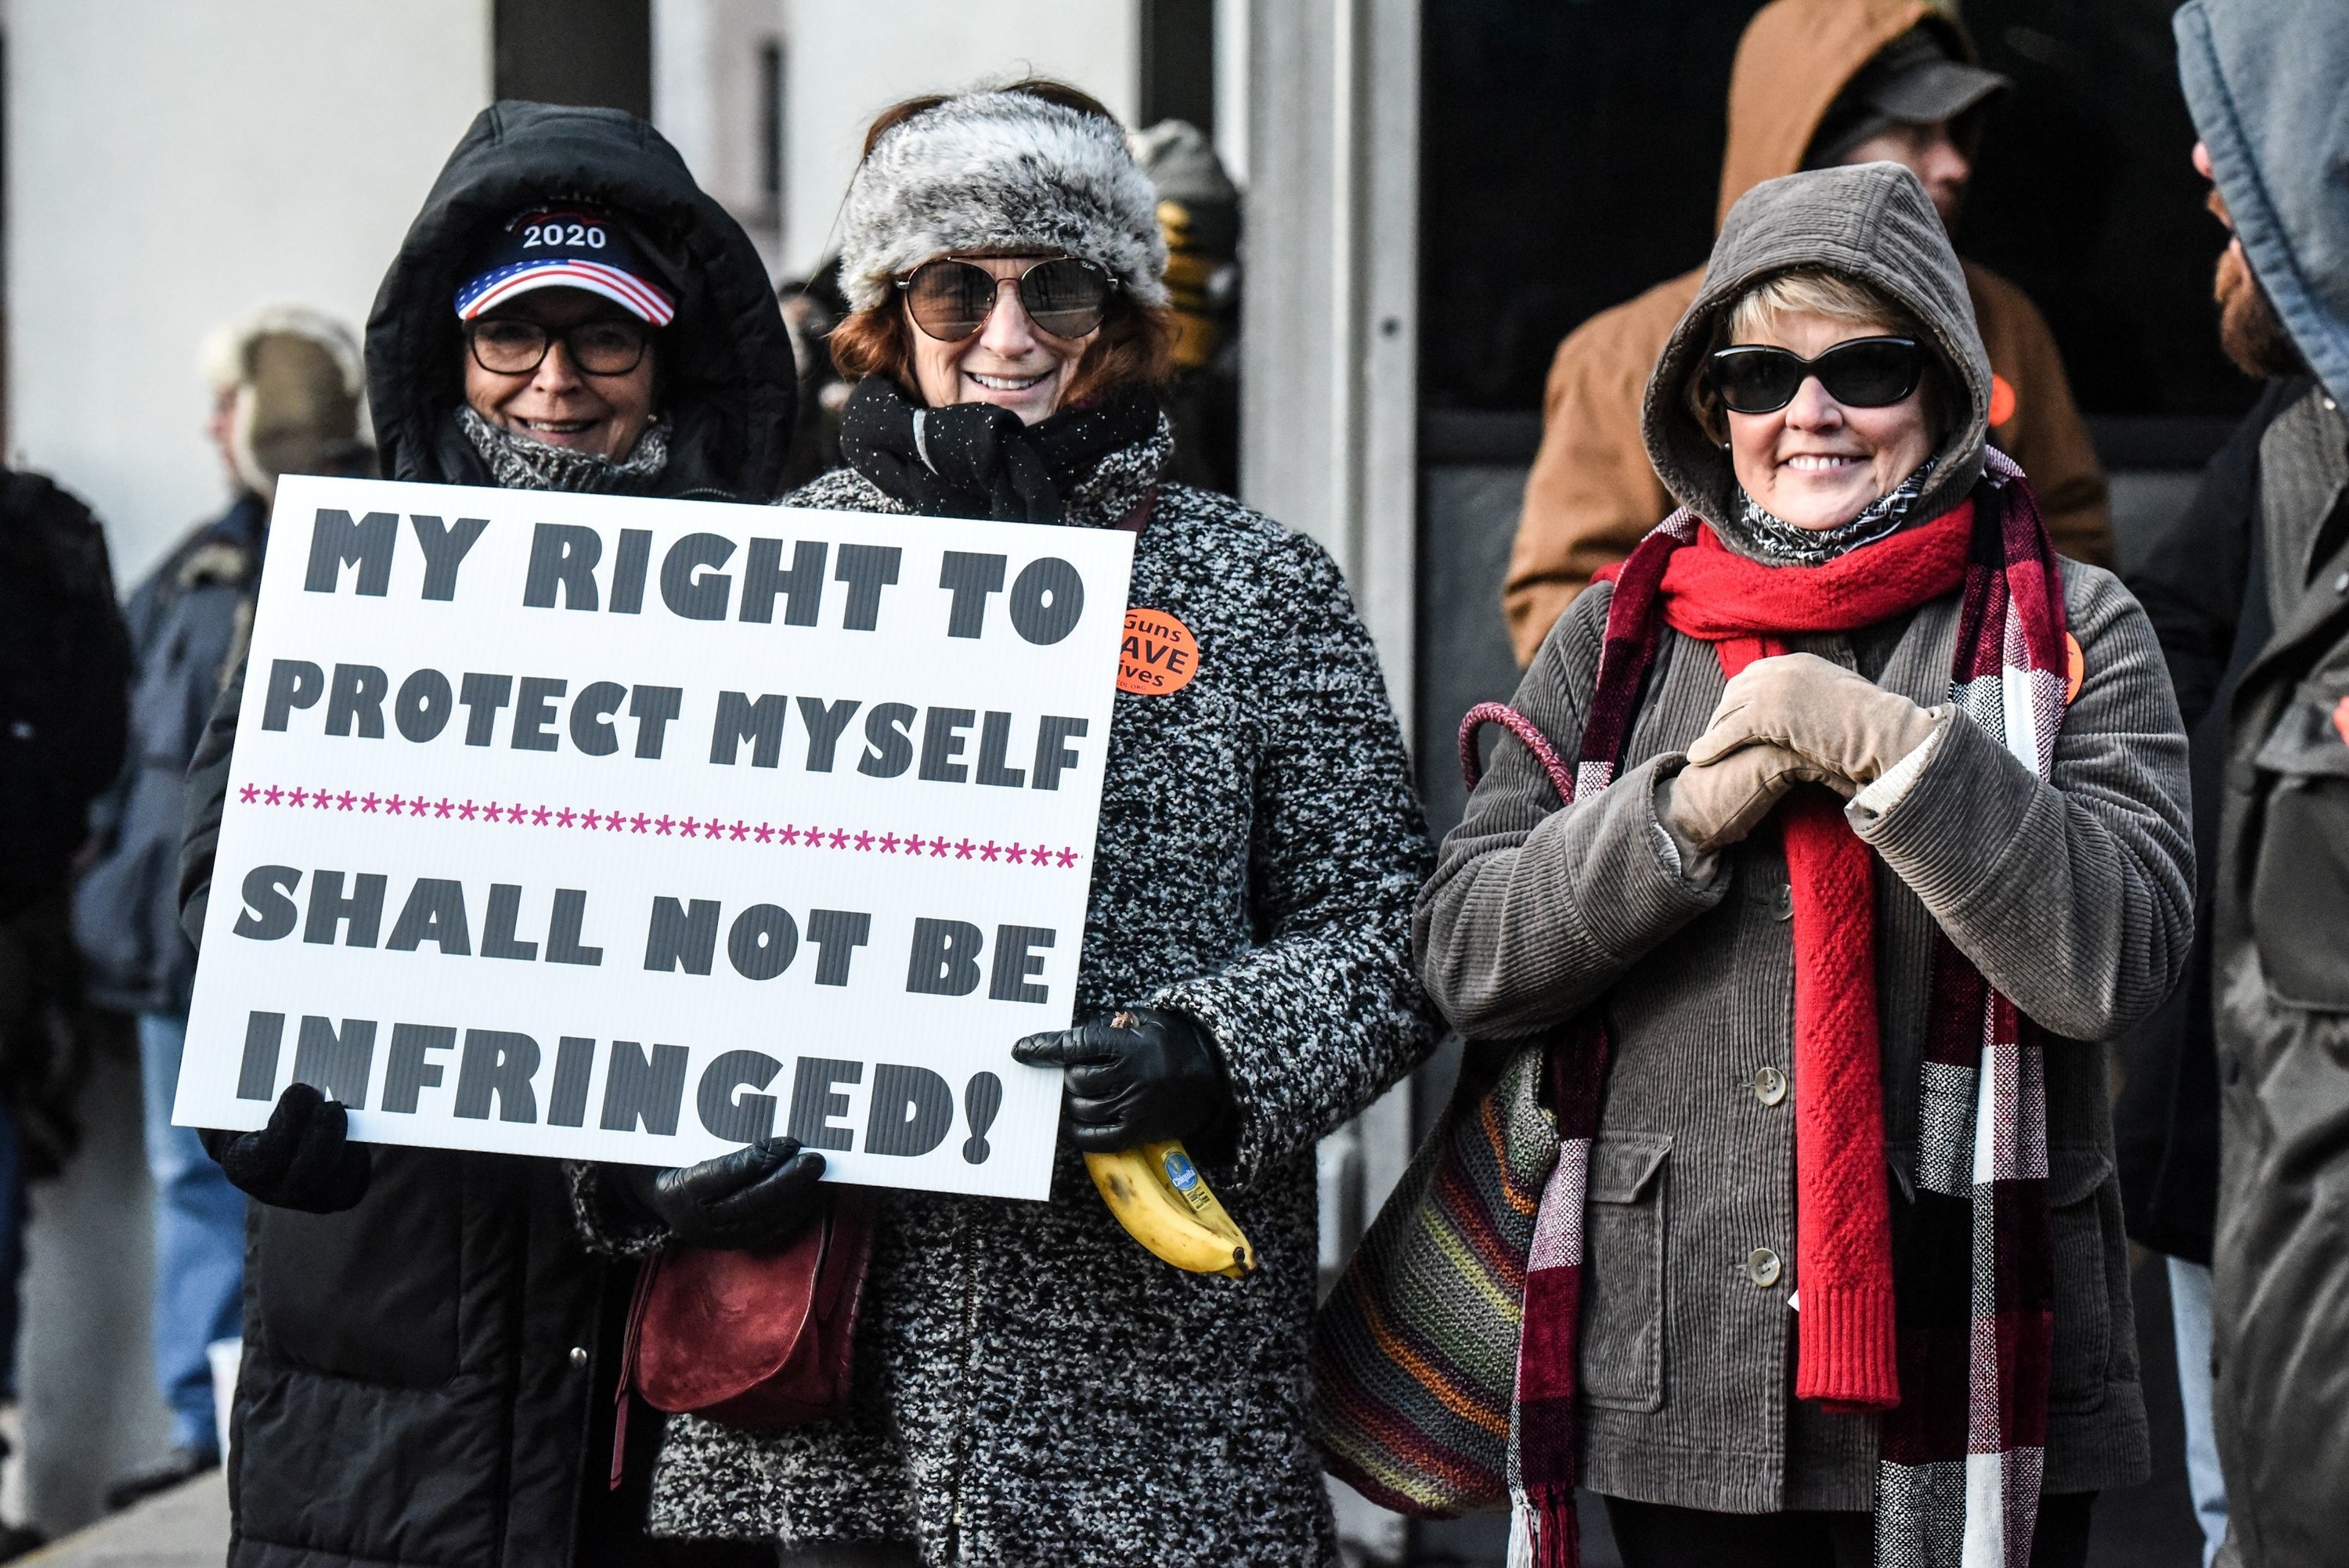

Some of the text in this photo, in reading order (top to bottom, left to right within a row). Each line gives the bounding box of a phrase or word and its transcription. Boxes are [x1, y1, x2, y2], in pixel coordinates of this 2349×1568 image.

[523, 224, 606, 248] 2020
[304, 509, 1084, 645] MY RIGHT TO
[1124, 614, 1182, 642] Guns
[1117, 660, 1165, 687] ives
[1120, 636, 1189, 675] AVE
[262, 659, 1088, 791] PROTECT MYSELF
[233, 865, 1056, 1004] SHALL NOT BE
[236, 1011, 1002, 1165] INFRINGED!
[1172, 1169, 1196, 1187] Chiquita
